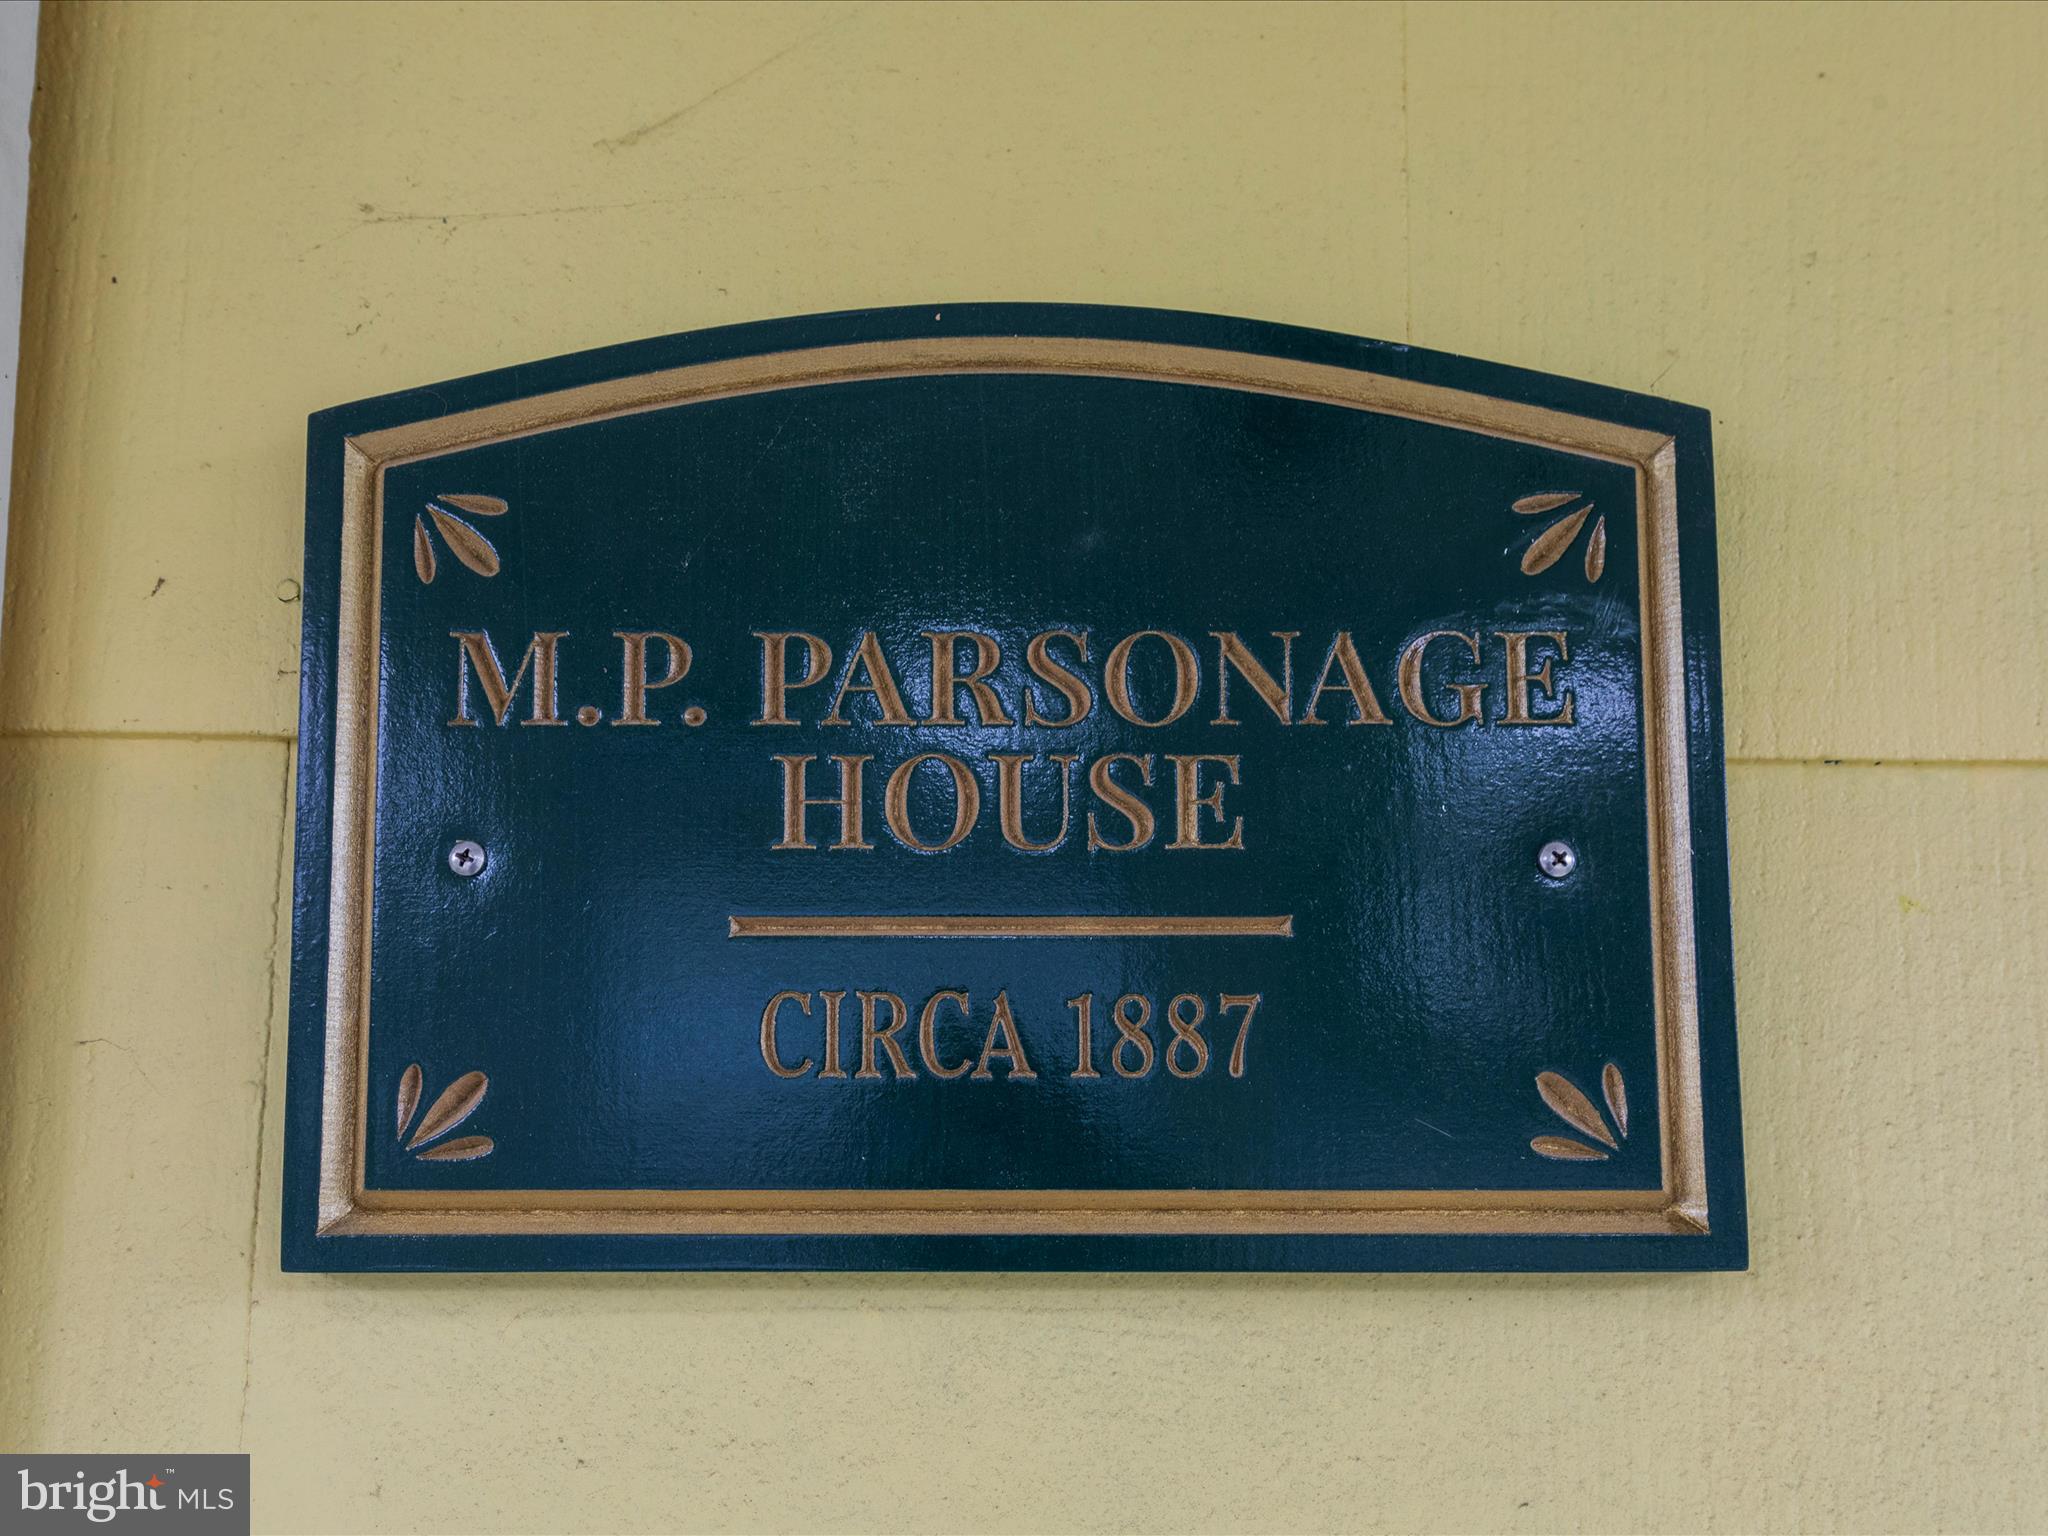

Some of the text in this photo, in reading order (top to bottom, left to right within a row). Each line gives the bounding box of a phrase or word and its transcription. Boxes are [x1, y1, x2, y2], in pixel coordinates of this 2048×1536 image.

[446, 630, 1574, 728] M.P. PARSONAGE
[771, 754, 1244, 852] HOUSE
[760, 991, 1261, 1079] CIRCA 1887
